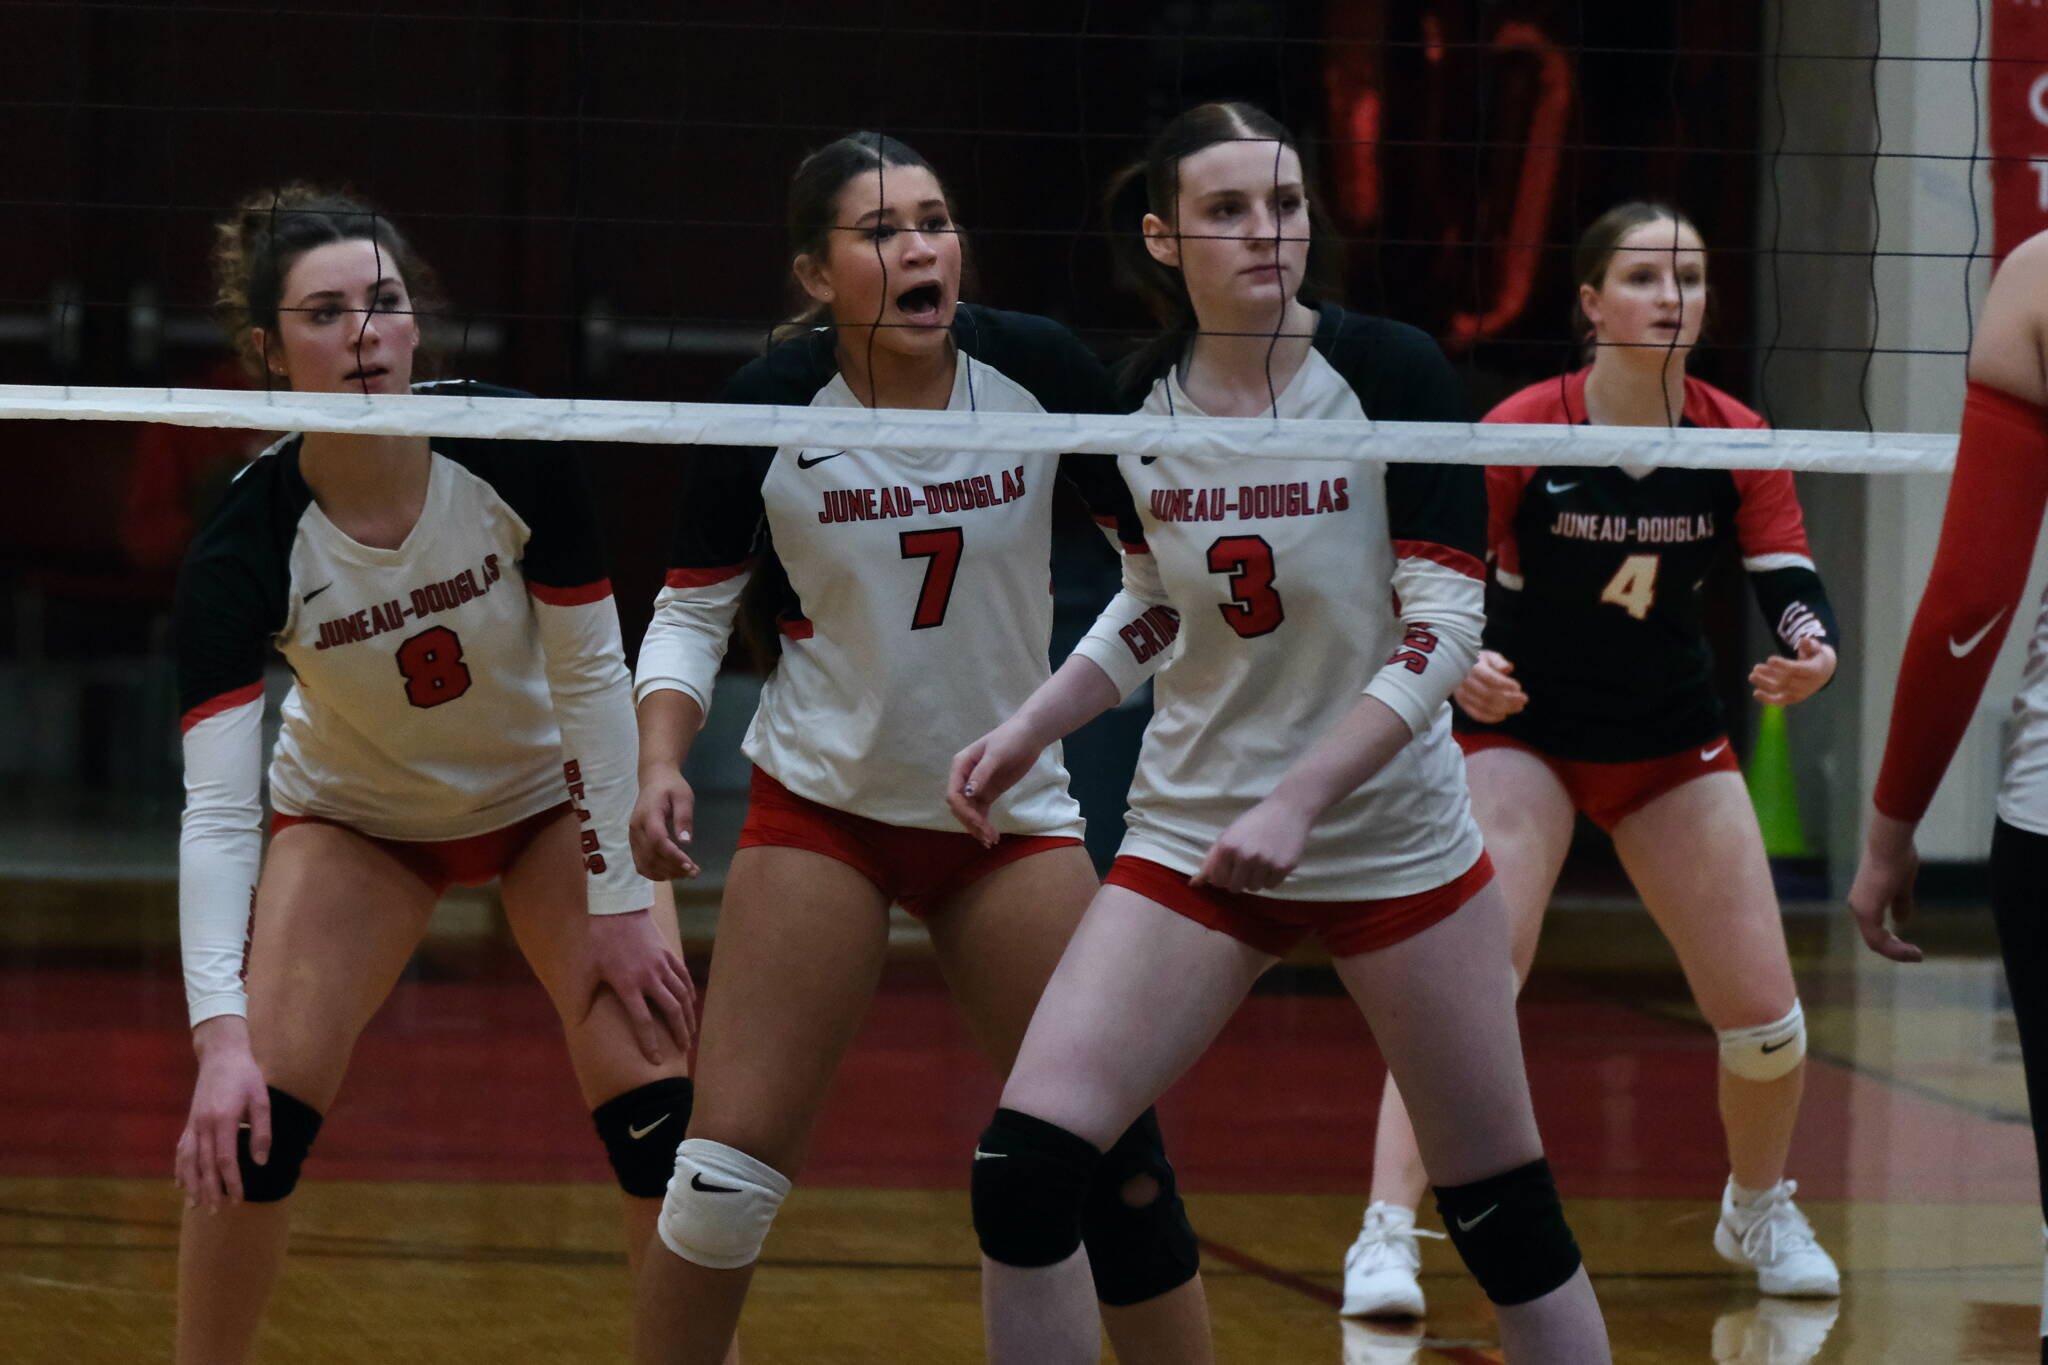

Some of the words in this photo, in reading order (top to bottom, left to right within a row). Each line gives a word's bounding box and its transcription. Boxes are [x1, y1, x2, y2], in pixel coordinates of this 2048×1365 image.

[818, 465, 1026, 524] JUNEAU-DOUGLAS
[1149, 477, 1350, 522] JUNEAU-DOUGLAS
[899, 526, 964, 631] 7
[1206, 534, 1285, 639] 3
[1599, 552, 1663, 621] 4
[395, 624, 473, 709] 8
